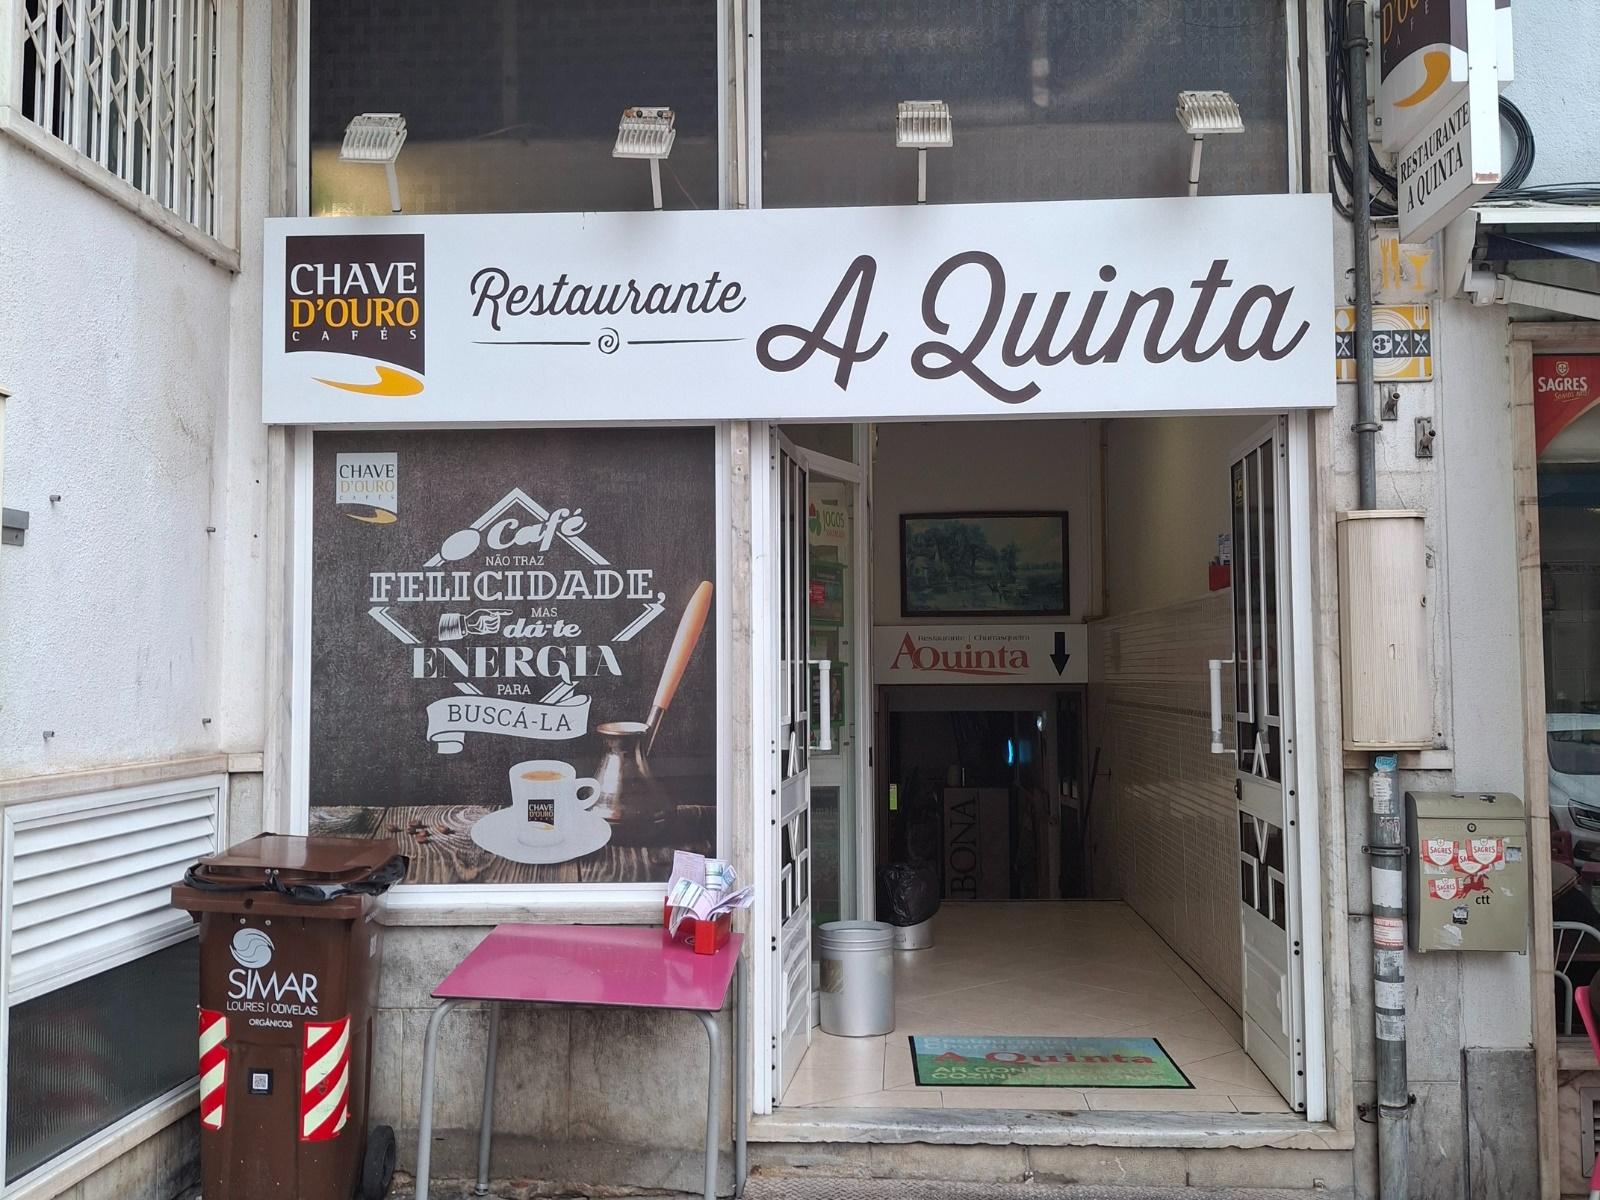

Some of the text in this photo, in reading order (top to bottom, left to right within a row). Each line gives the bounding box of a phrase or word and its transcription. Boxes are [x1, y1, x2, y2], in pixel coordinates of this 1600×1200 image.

[1400, 101, 1470, 185] RESTAURANTE
[1406, 142, 1464, 214] A QUINTA
[290, 262, 417, 296] CHAVE
[289, 297, 420, 328] D'OURO
[291, 327, 418, 342] CAFÉS
[470, 250, 1311, 404] Restaurante A Quinta
[1538, 376, 1589, 393] SAGRES
[339, 463, 395, 479] CHAVE
[340, 480, 395, 494] D'OURO
[486, 508, 588, 552] Café
[485, 554, 545, 566] NÃO TRAZ
[369, 569, 667, 605] FELICIDADE,
[531, 607, 558, 618] MAS
[503, 617, 583, 639] dá-te
[412, 645, 623, 686] ENERGIA
[497, 684, 532, 696] PARA
[447, 704, 572, 732] BUSCÁ-LA
[528, 803, 554, 812] CHAVE
[1430, 846, 1452, 855] SAGRES
[1473, 845, 1496, 854] SAGRES
[1437, 883, 1456, 891] SAGRES
[1475, 895, 1491, 905] ctt
[227, 968, 319, 1004] SIMAR
[226, 1000, 319, 1016] LOURES ODIVELAS
[934, 1050, 1158, 1065] A Quinta
